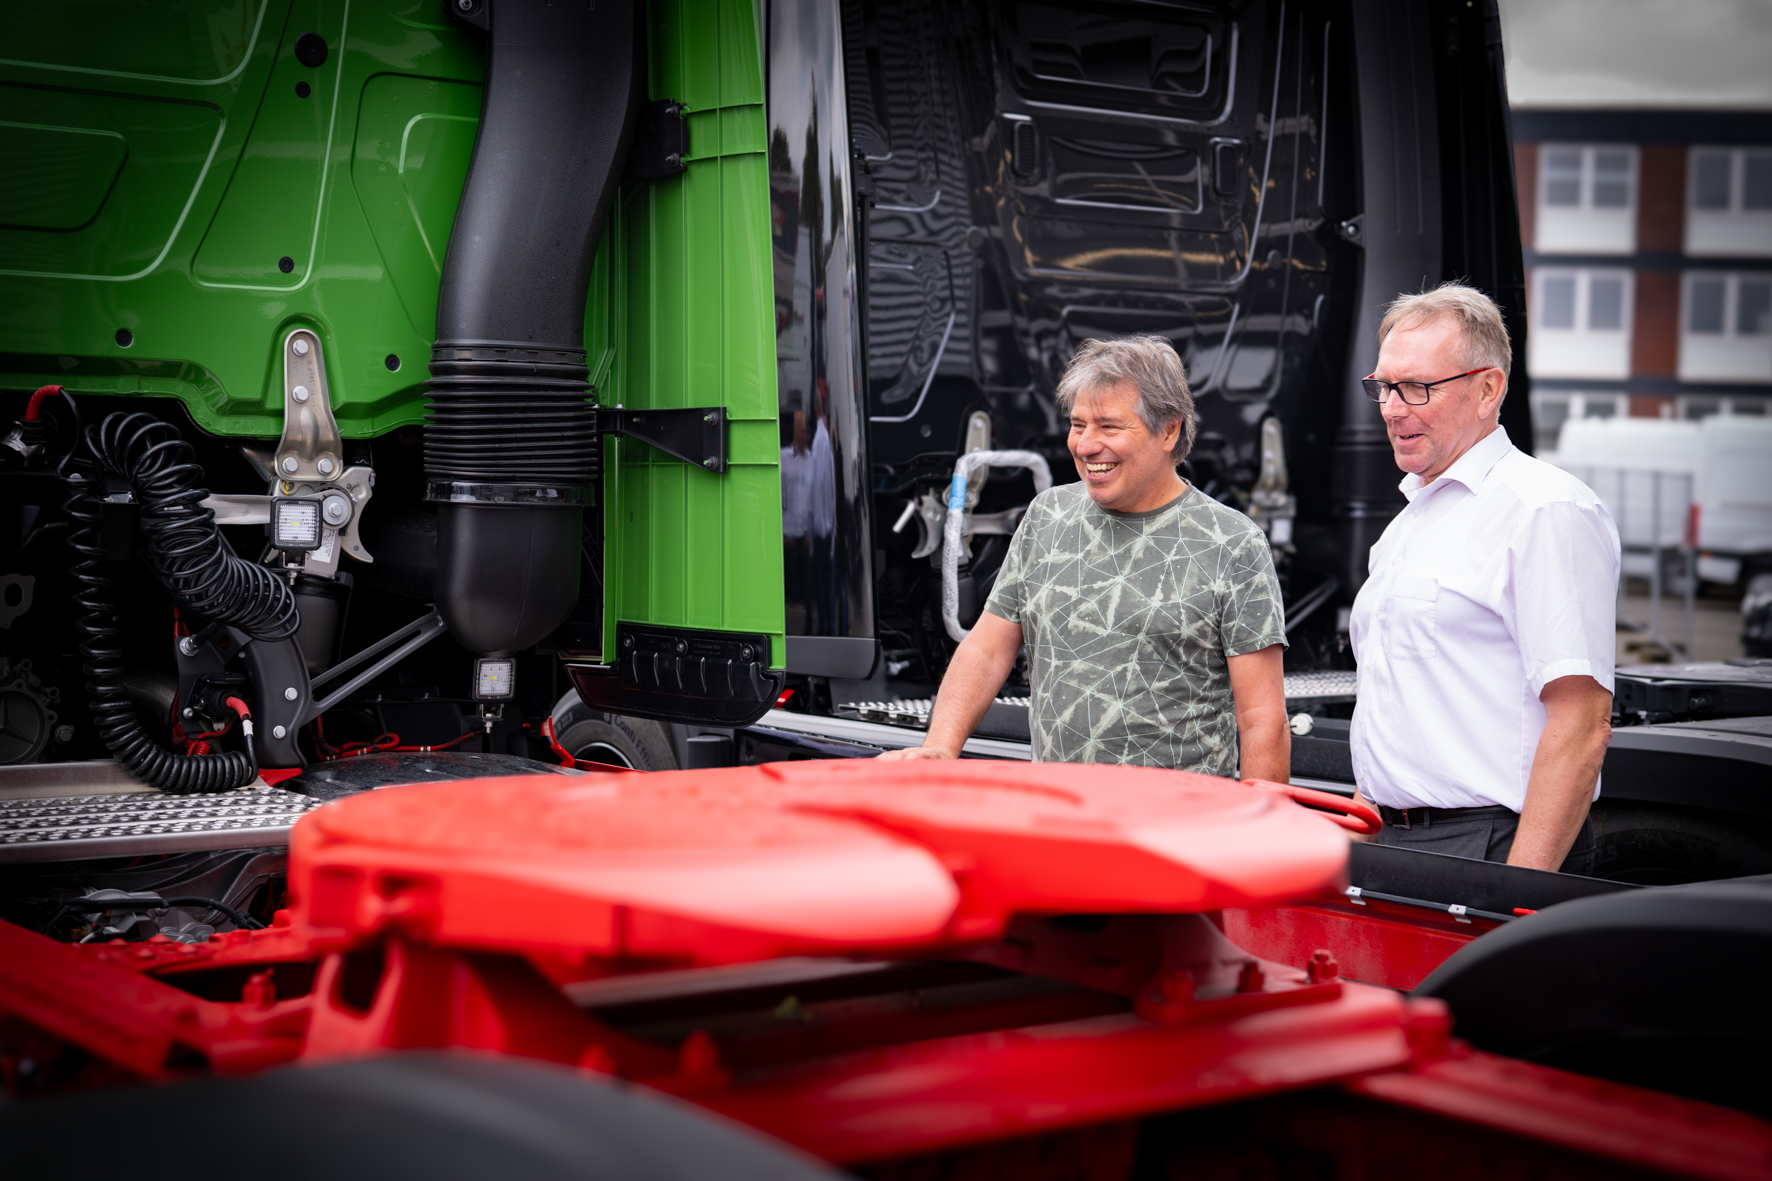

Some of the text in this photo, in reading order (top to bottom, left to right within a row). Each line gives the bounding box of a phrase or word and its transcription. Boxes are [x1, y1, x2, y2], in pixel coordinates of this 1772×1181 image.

[614, 714, 655, 771] Conti Effic
[1594, 844, 1618, 866] 2.5
